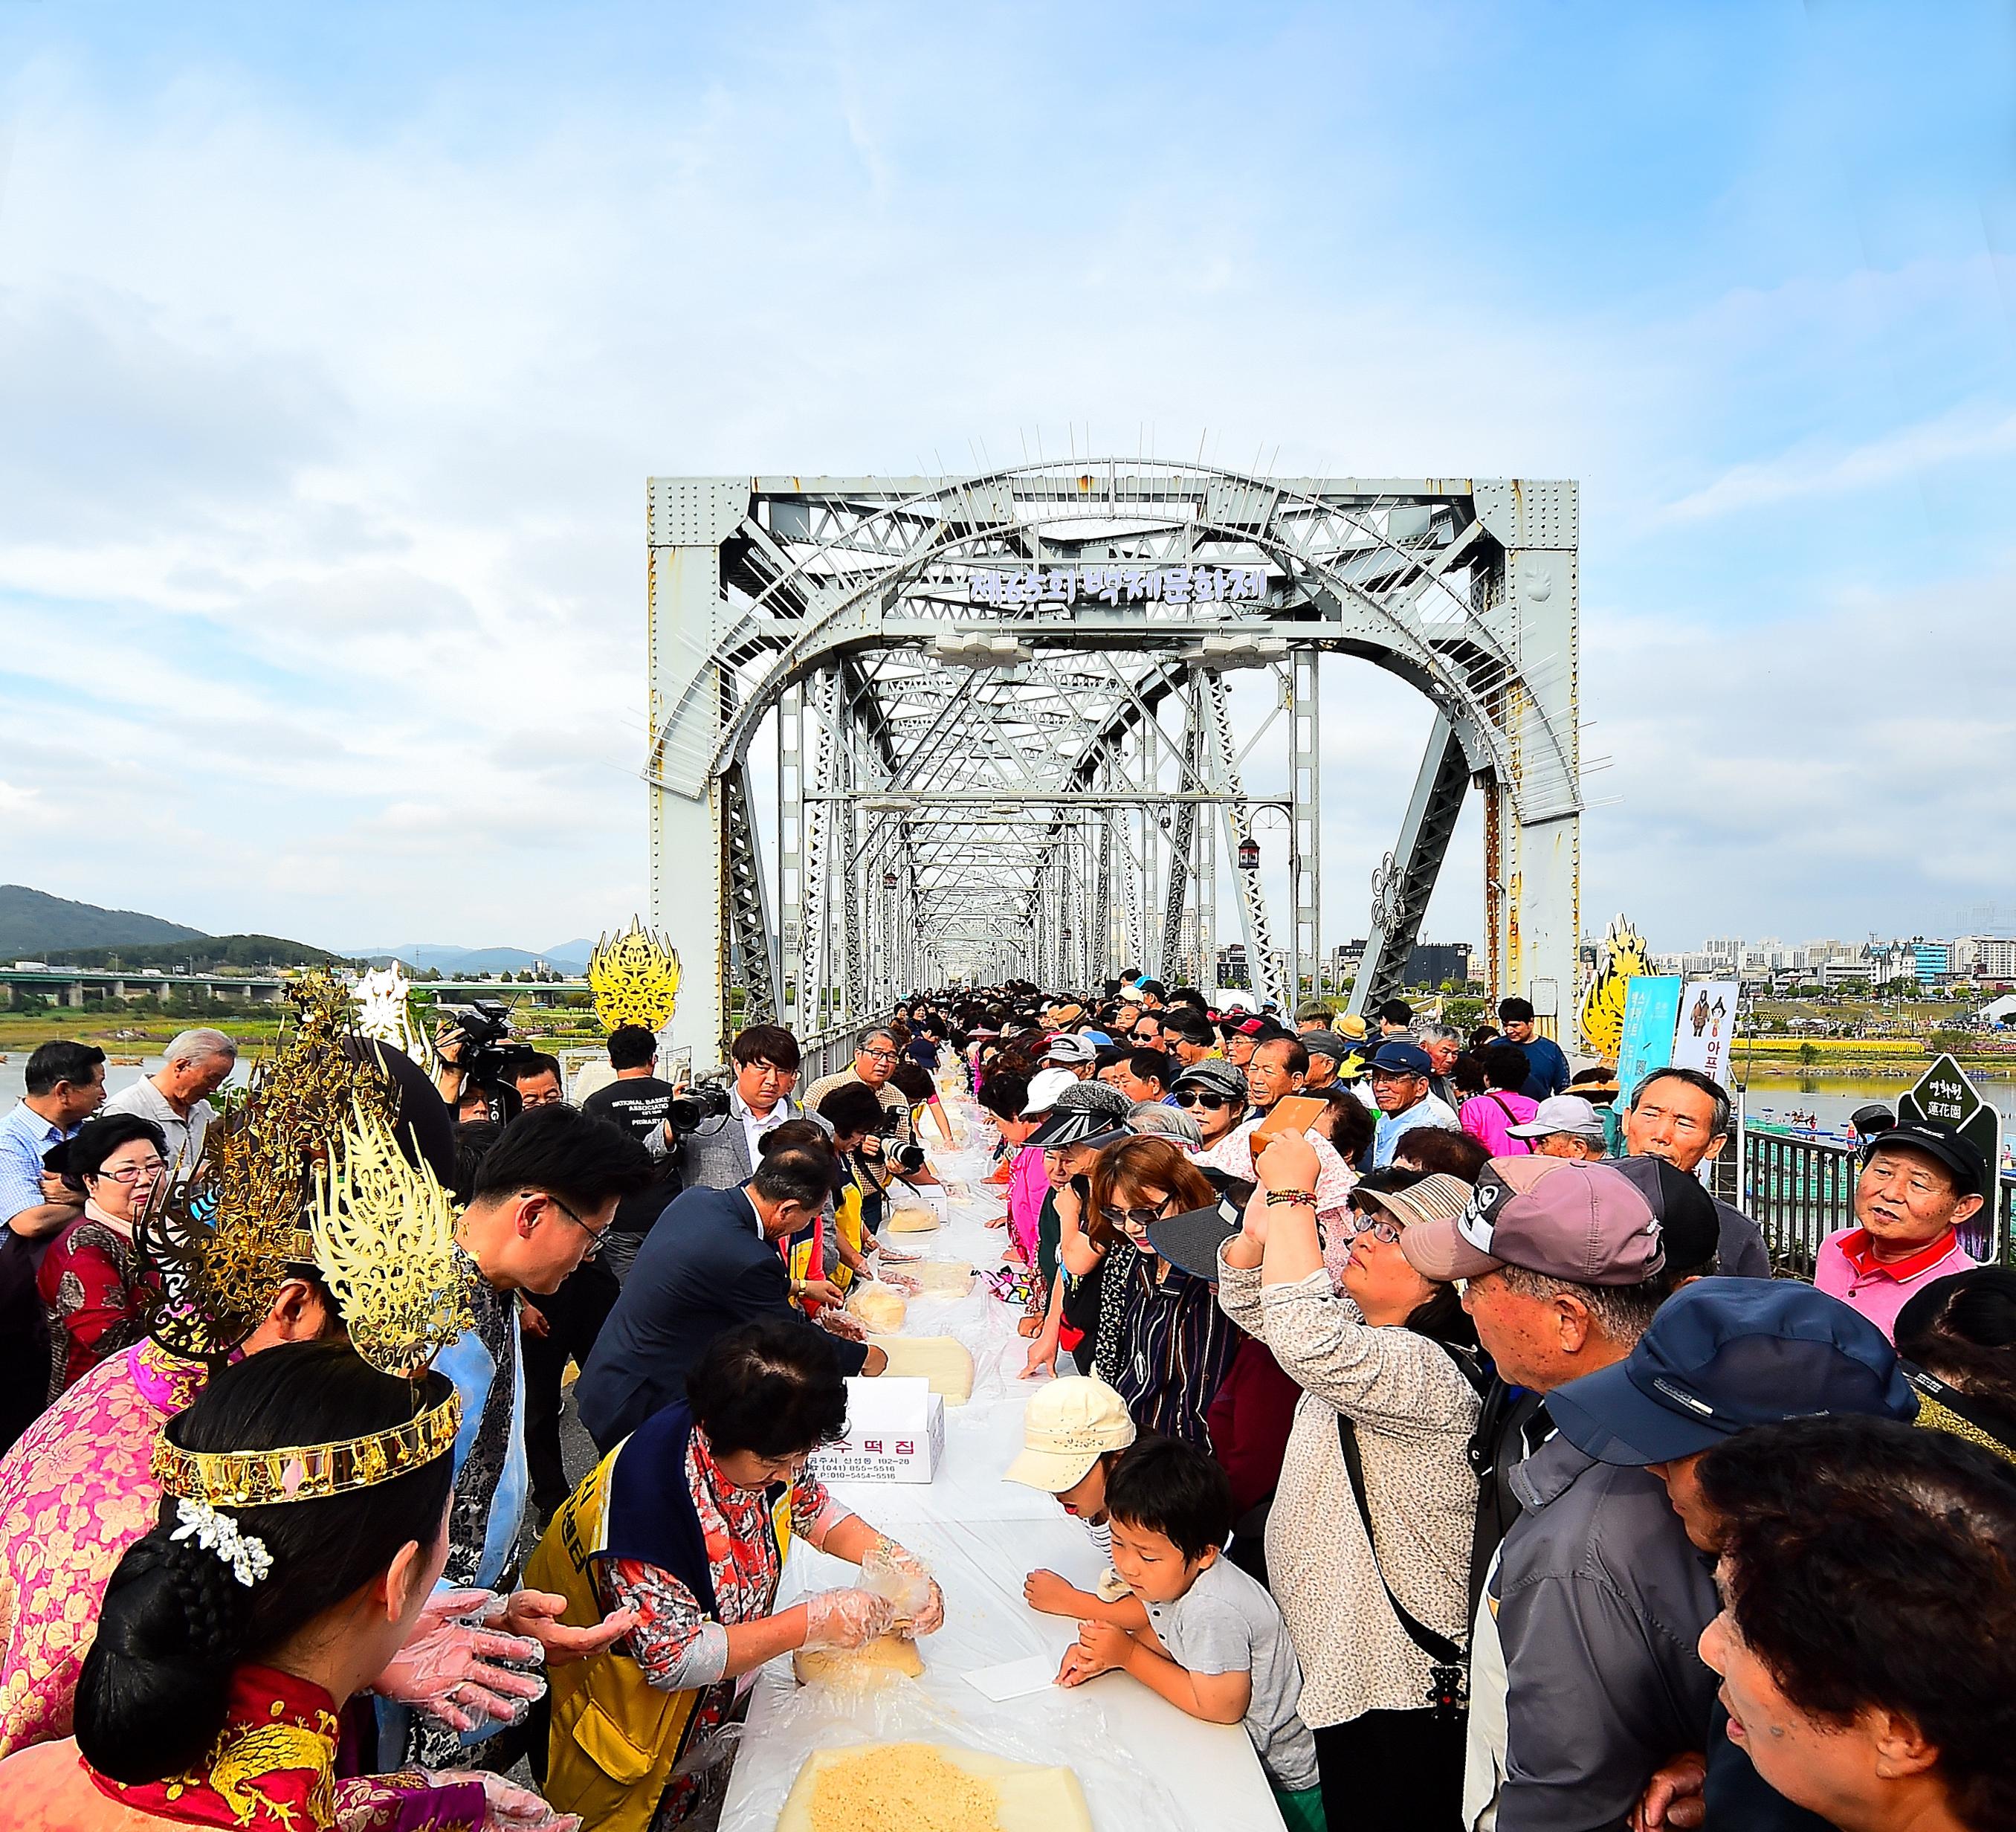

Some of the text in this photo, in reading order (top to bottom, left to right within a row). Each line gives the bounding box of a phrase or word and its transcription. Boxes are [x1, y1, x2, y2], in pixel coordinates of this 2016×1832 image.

[969, 567, 1267, 607] 제65회 백제문화제
[612, 1100, 645, 1108] NATIONAL
[1928, 1101, 1962, 1120] 蓮花園
